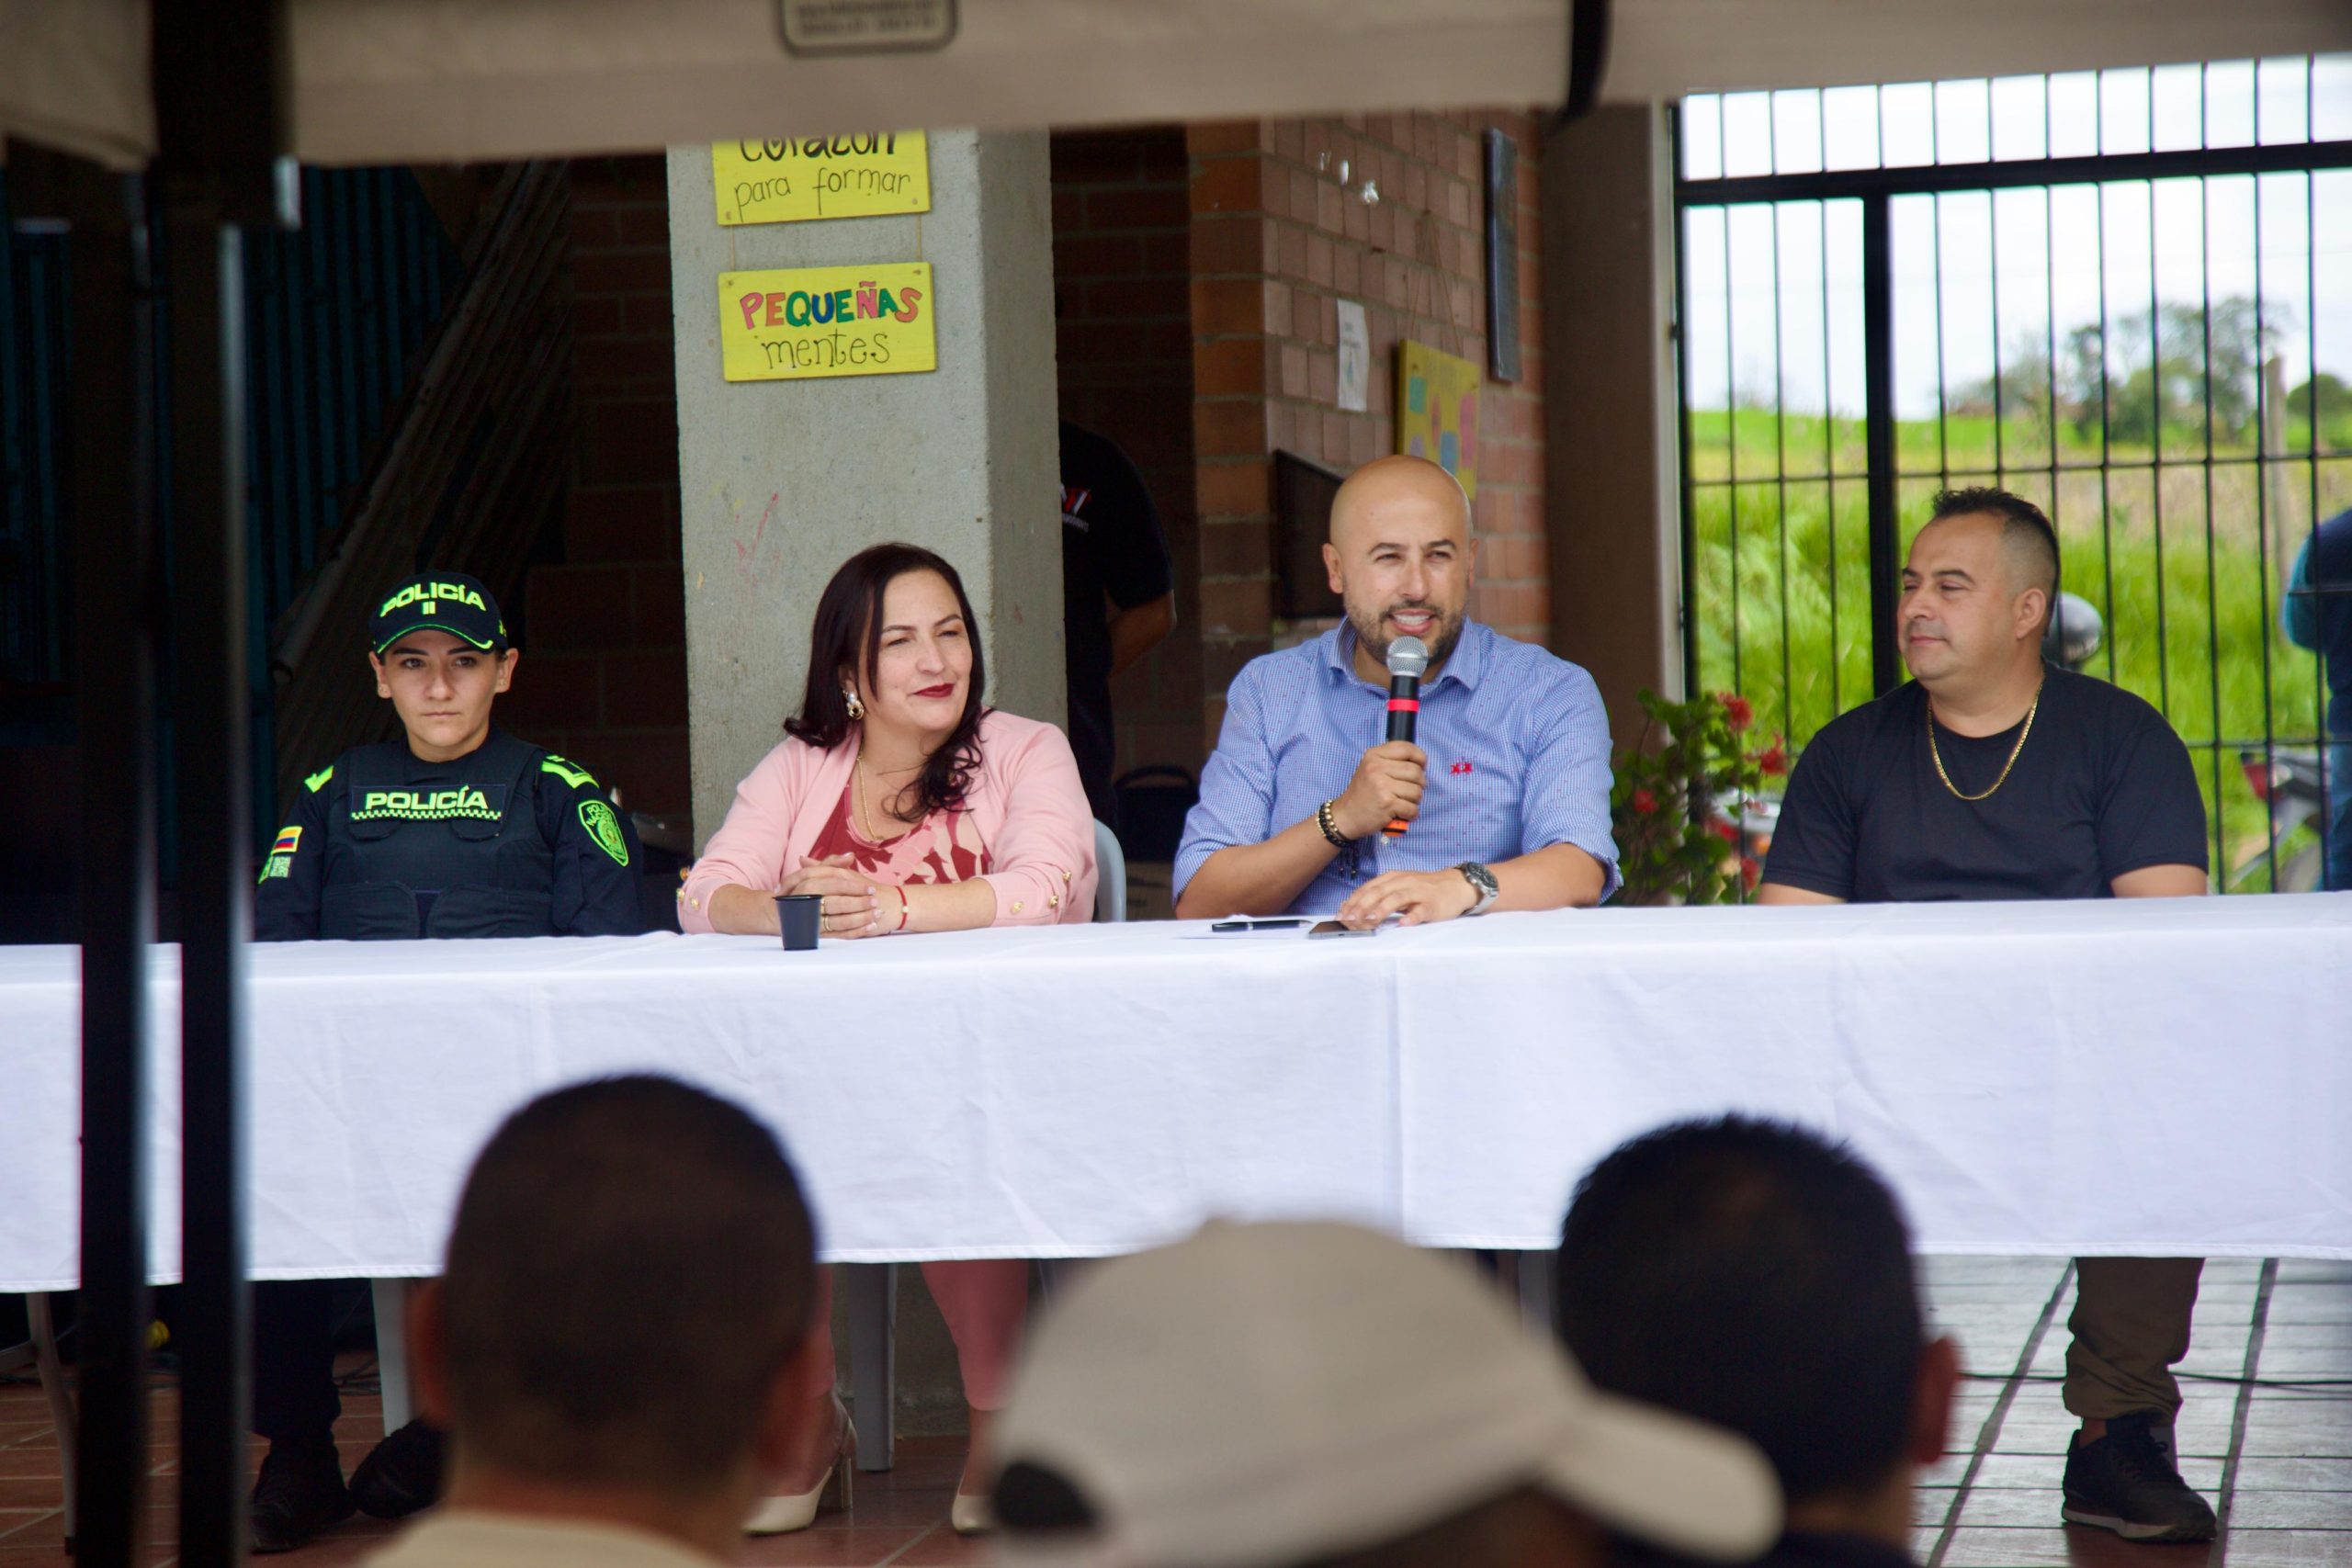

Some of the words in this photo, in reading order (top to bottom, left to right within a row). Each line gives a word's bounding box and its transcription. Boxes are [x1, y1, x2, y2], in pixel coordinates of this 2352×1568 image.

[734, 176, 791, 222] para
[812, 167, 910, 215] formar
[740, 281, 922, 330] PEQUEÑAS
[761, 328, 889, 369] mentes
[379, 581, 486, 617] POLICÍA
[366, 784, 489, 810] POLICÍA
